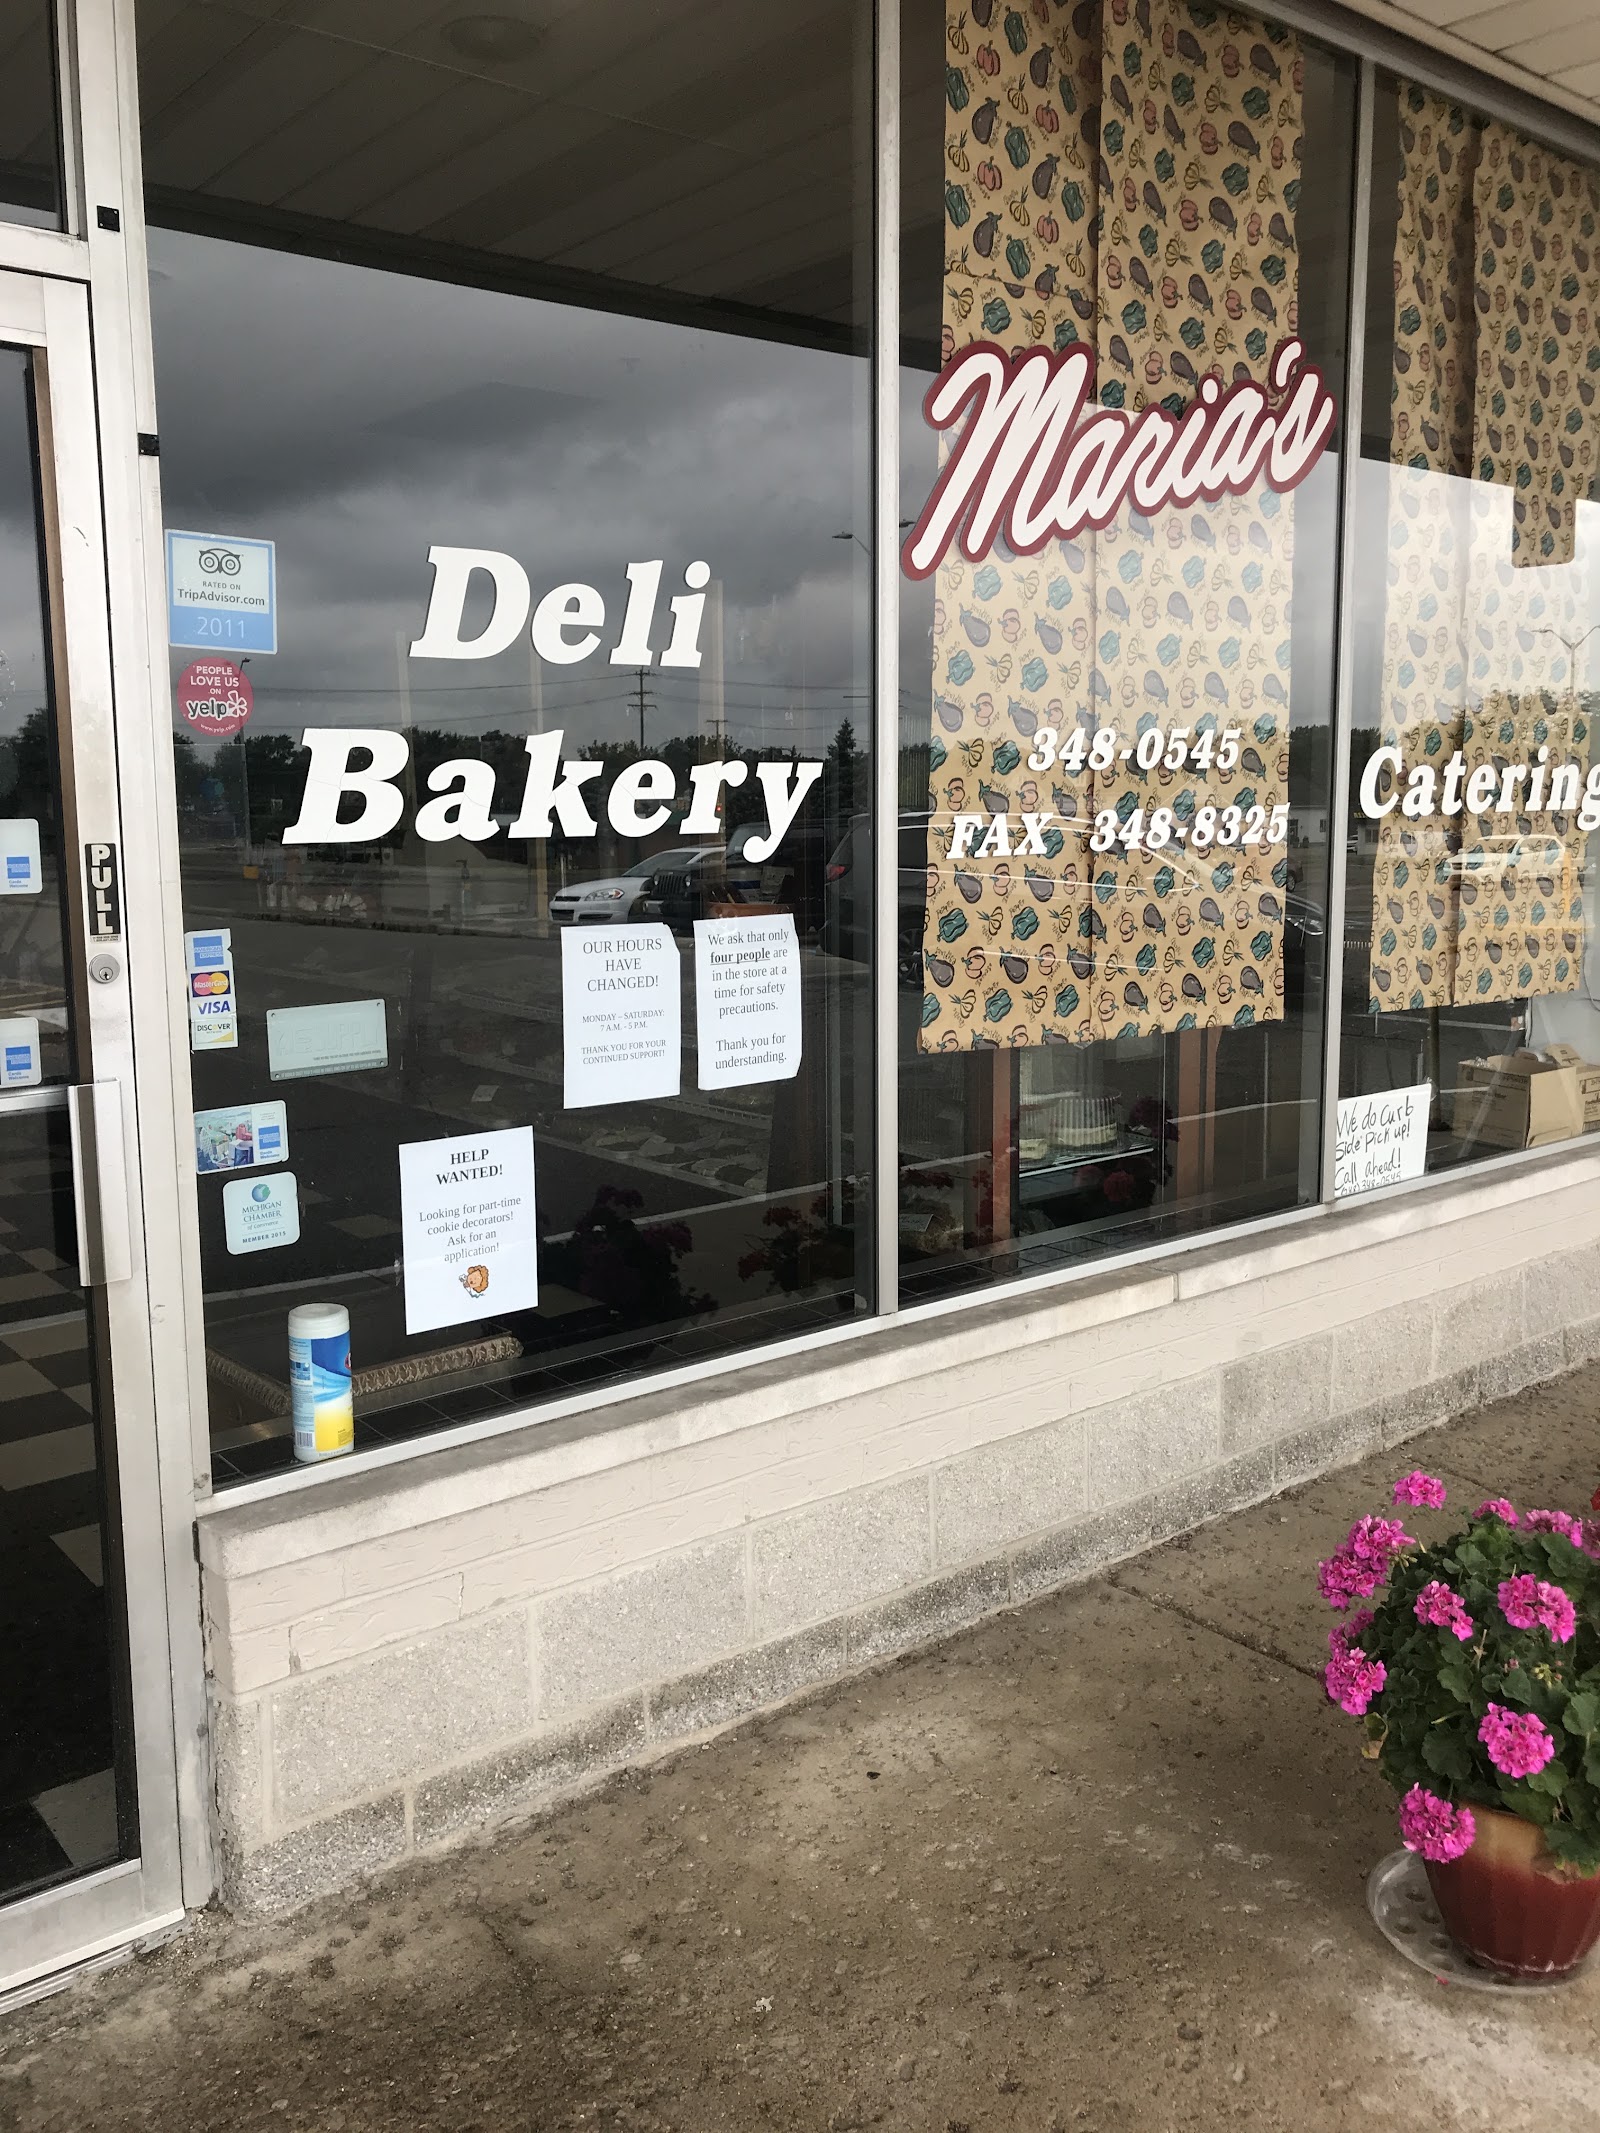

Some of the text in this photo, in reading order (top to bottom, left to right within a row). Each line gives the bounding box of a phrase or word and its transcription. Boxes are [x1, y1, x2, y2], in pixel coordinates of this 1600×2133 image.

[900, 336, 1337, 580] Maria's
[203, 580, 227, 590] RATED
[178, 588, 265, 606] TripAdvisor.com
[409, 545, 712, 668] Deli
[197, 616, 246, 639] 2011
[196, 666, 232, 676] PEOPLE
[190, 675, 240, 687] LOVE US
[186, 698, 228, 720] yelp
[201, 723, 236, 733] www.yelp.com
[1027, 726, 1241, 771] 348-0545
[282, 728, 823, 863] Bakery
[946, 802, 1290, 859] FAX 348-8325
[91, 844, 113, 934] PULL
[708, 928, 789, 946] We ask that only
[583, 938, 662, 954] OUR HOURS
[606, 957, 641, 972] HAVE
[710, 948, 788, 964] four people are
[712, 970, 722, 981] in
[725, 968, 740, 980] the
[743, 967, 767, 978] store
[770, 966, 779, 976] at
[194, 980, 229, 989] MasterCard
[587, 975, 659, 992] CHANGED!
[714, 982, 785, 999] time for safety
[198, 1000, 231, 1015] VISA
[719, 1000, 779, 1019] precautions.
[582, 1013, 617, 1023] MONDAY
[624, 1010, 665, 1019] SATURDAY:
[197, 1023, 231, 1031] DISCOVER
[606, 1023, 623, 1031] A.M.
[634, 1021, 648, 1029] P.M.
[581, 1039, 666, 1054] THANK YOU FOR YOUR
[716, 1033, 786, 1052] Thank you for
[583, 1050, 665, 1065] CONTINUED SUPPORT!
[715, 1050, 787, 1069] understanding.
[1337, 1102, 1358, 1138] We
[1361, 1102, 1376, 1130] do
[1336, 1136, 1361, 1161] Side
[1394, 1118, 1411, 1141] up!
[450, 1149, 489, 1165] HELP
[436, 1164, 503, 1185] WANTED!
[1334, 1162, 1357, 1191] Call
[242, 1201, 282, 1213] MICHIGAN
[419, 1196, 521, 1222] Looking for part-time
[243, 1210, 282, 1222] CHAMBER
[427, 1212, 514, 1235] cookie decorators!
[242, 1234, 269, 1243] MEMBER
[447, 1230, 496, 1247] Ask for an
[444, 1242, 500, 1263] application!
